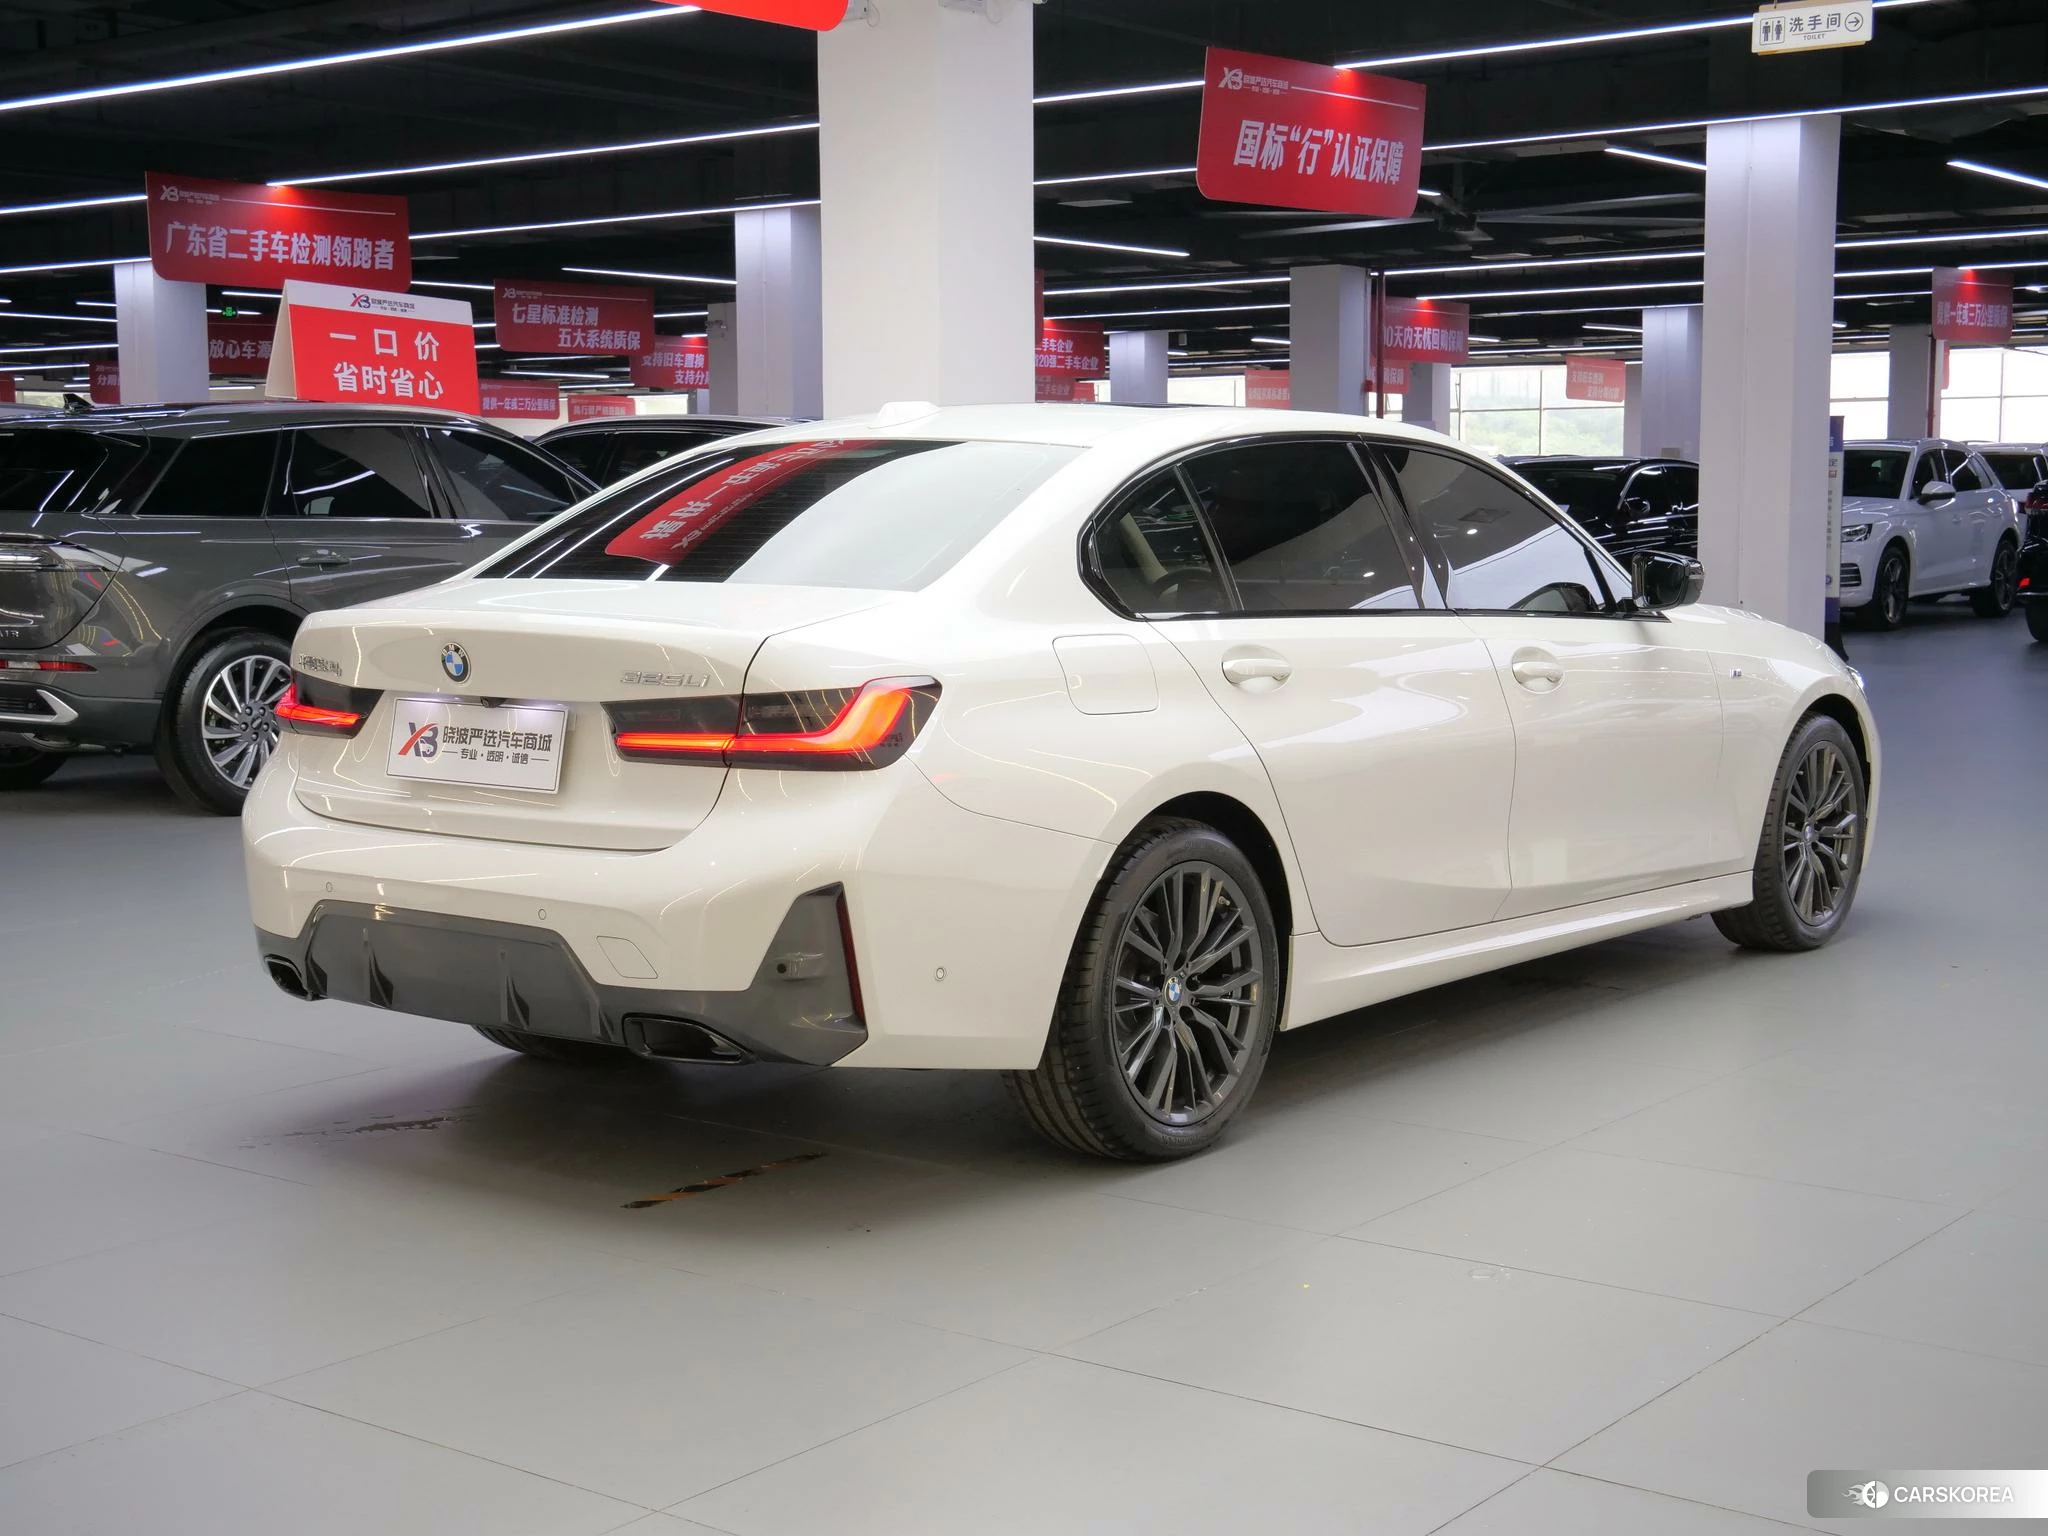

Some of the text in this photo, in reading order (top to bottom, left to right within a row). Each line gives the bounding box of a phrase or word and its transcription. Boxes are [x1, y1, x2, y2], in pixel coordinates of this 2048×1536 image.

[1789, 13, 1841, 32] 洗手间
[166, 221, 395, 271] 广东省二手车检测领跑者
[512, 303, 599, 327] 七星标准检测
[329, 328, 440, 362] 一口价
[558, 328, 641, 350] 五大系统质保
[333, 361, 444, 400] 省时省心
[620, 671, 711, 687] 325Li
[442, 726, 553, 752] 晓波严选汽车商城
